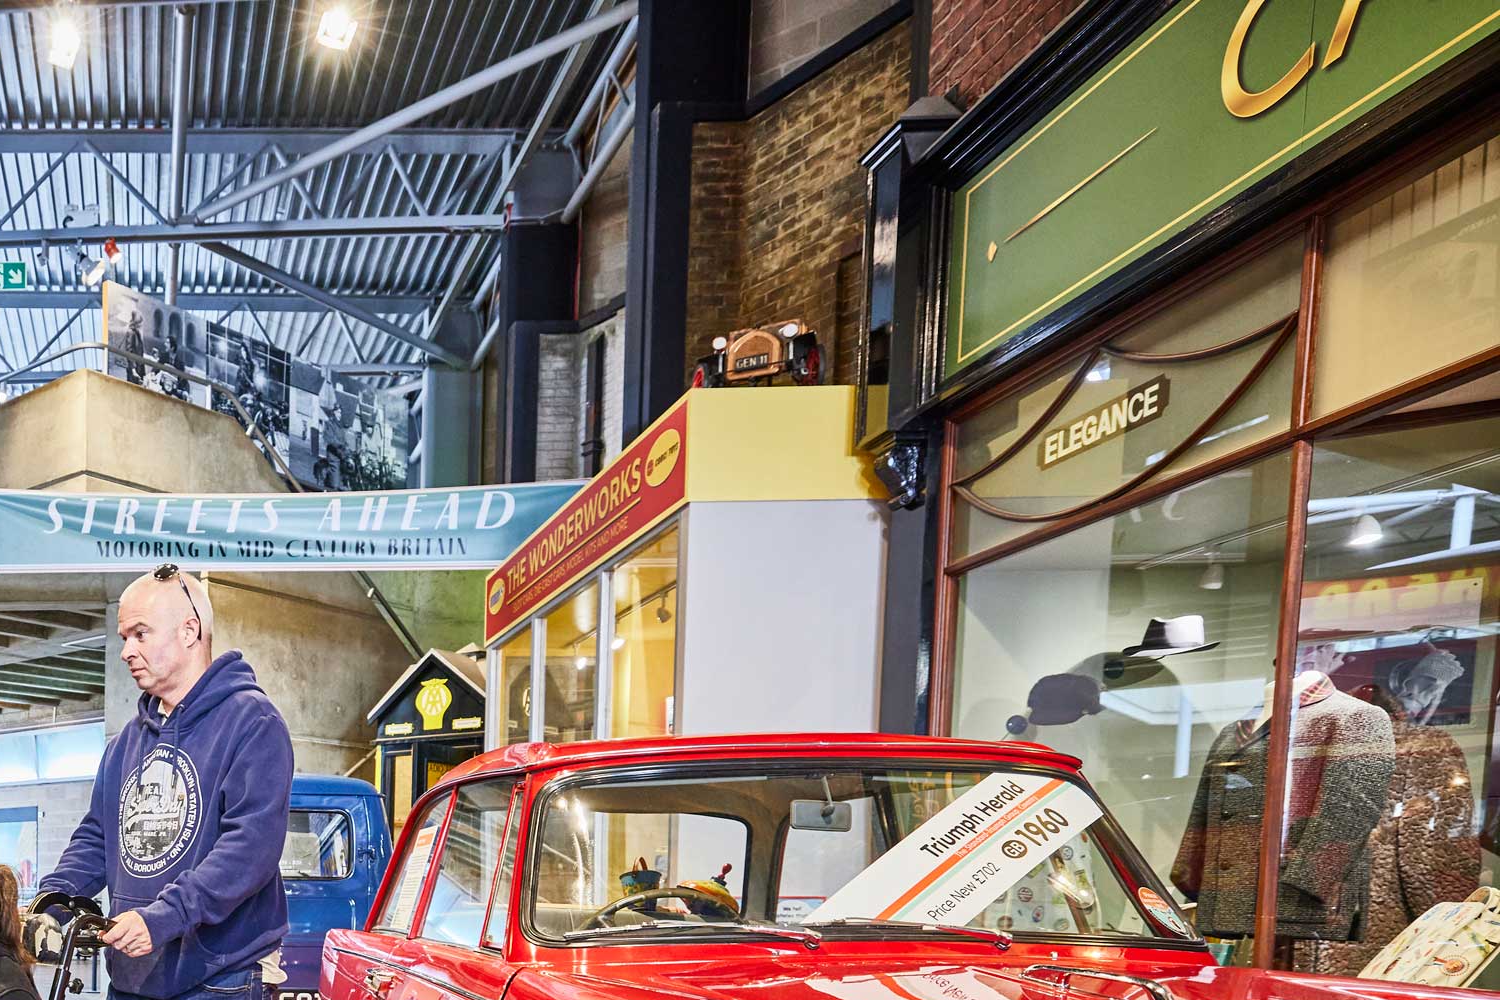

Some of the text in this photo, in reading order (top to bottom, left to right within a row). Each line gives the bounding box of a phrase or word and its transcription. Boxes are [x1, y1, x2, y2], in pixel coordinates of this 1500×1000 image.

[736, 357, 757, 369] GEN
[1043, 382, 1160, 465] ELEGANCE
[44, 490, 515, 535] STREETS AHEAD
[507, 457, 642, 594] THE WONDERWORKS
[96, 536, 468, 559] MOTORING IN MID CENTURY BRITAIN
[169, 828, 193, 858] ISLAND
[920, 812, 985, 858] Triumph
[975, 780, 1026, 818] Herald
[1004, 808, 1069, 857] GB 1960
[928, 862, 1001, 921] Price New £702
